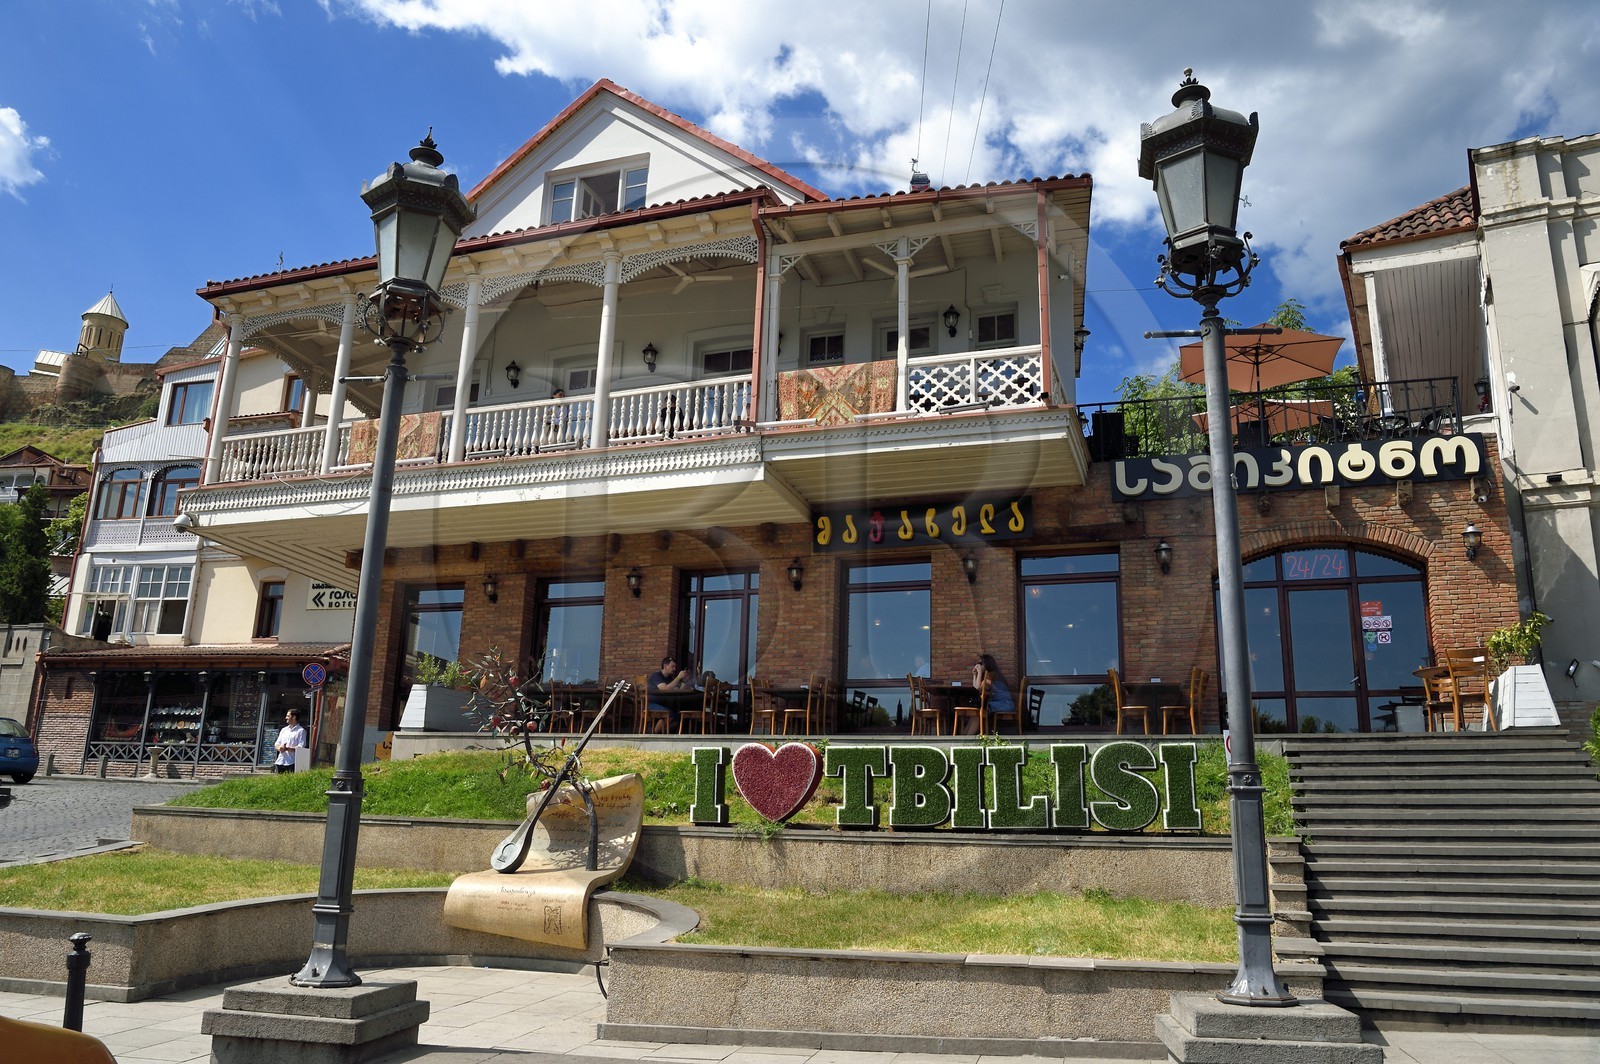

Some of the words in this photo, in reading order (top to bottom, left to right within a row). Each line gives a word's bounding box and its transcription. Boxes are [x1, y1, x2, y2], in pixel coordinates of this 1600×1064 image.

[1286, 553, 1344, 579] 24/24
[689, 745, 729, 825] I
[824, 741, 1203, 831] TBILISI
